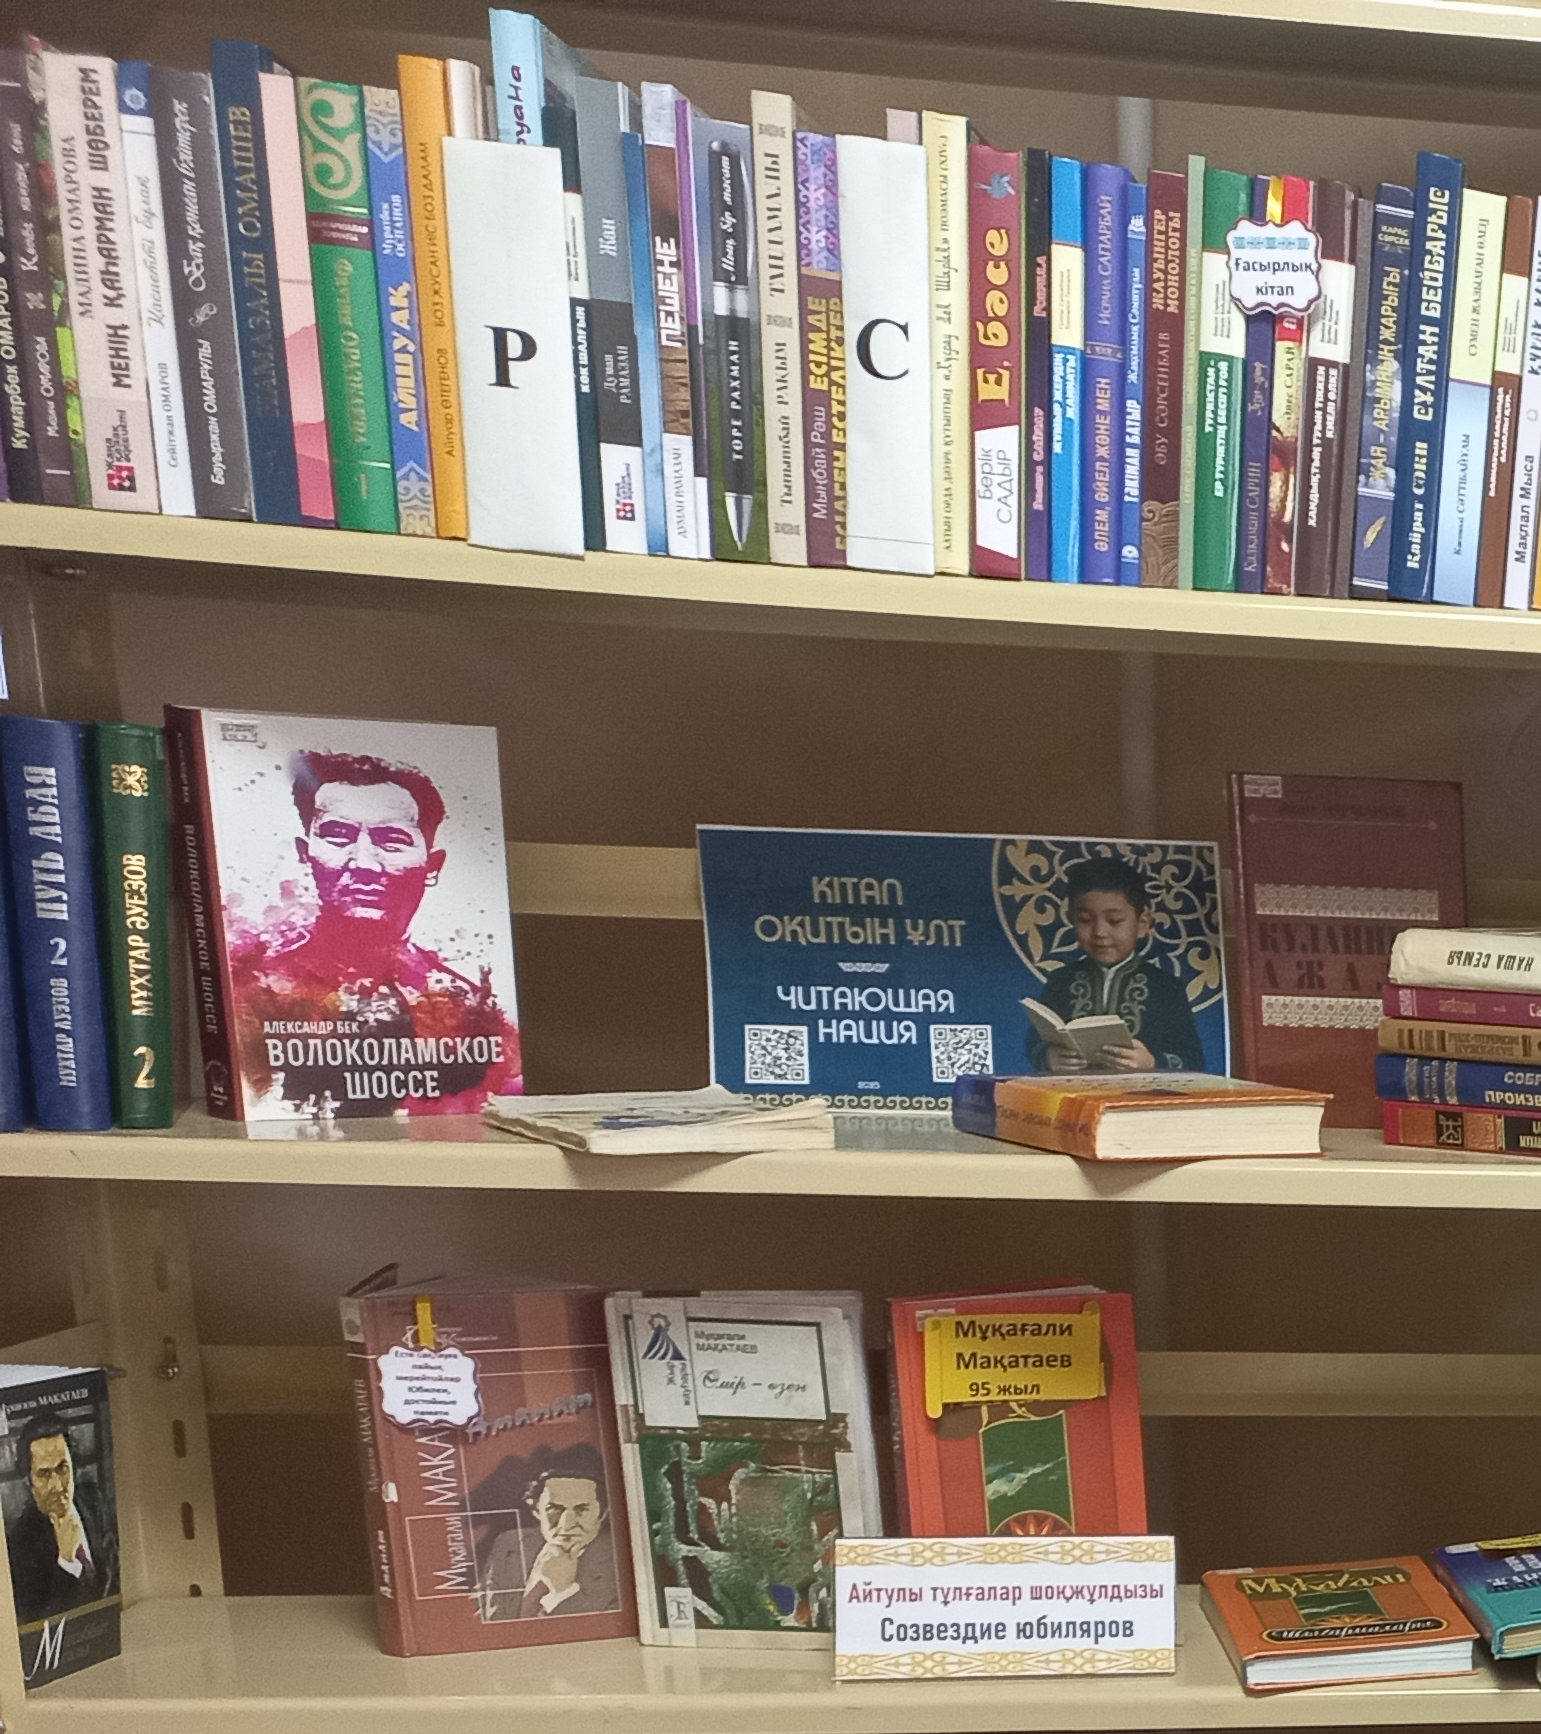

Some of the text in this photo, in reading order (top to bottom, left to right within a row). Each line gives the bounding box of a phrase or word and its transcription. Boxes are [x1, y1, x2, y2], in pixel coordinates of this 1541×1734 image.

[1152, 209, 1167, 311] ЖАУЫНГЕР
[1167, 211, 1181, 314] МОНОЛОГЫ
[1234, 257, 1314, 276] Ғасырлық
[655, 236, 683, 347] ПЕШЕНЕ
[1255, 282, 1295, 299] кітап
[391, 283, 418, 431] АЙШУАҚ
[484, 325, 538, 389] Р
[808, 298, 829, 391] ЕСІМДЕ
[856, 318, 911, 381] С
[978, 447, 994, 500] Берік
[996, 450, 1014, 525] САДЫР
[24, 765, 72, 921] ПУТЬ АБАЯ
[812, 876, 905, 908] КІТАП
[754, 916, 898, 948] ОҚИТЫН
[49, 938, 69, 967] 2
[776, 985, 956, 1016] ЧИТАЮЩАЯ
[263, 1019, 361, 1035] АЛЕКСАНДР БЕК
[817, 1019, 919, 1046] НАЦИЯ
[265, 1033, 505, 1068] ВОЛОКОЛАМСКОЕ
[132, 1045, 157, 1090] 2
[344, 1070, 442, 1101] ШОССЕ
[954, 1318, 1074, 1343] Мұқағали
[955, 1350, 1073, 1374] Мақатаев
[968, 1380, 1041, 1398] 95 жыл
[848, 1580, 1164, 1607] Айтулы тұлғалар шоқжұлдызы
[880, 1615, 1134, 1644] Созвездие юбиляров
